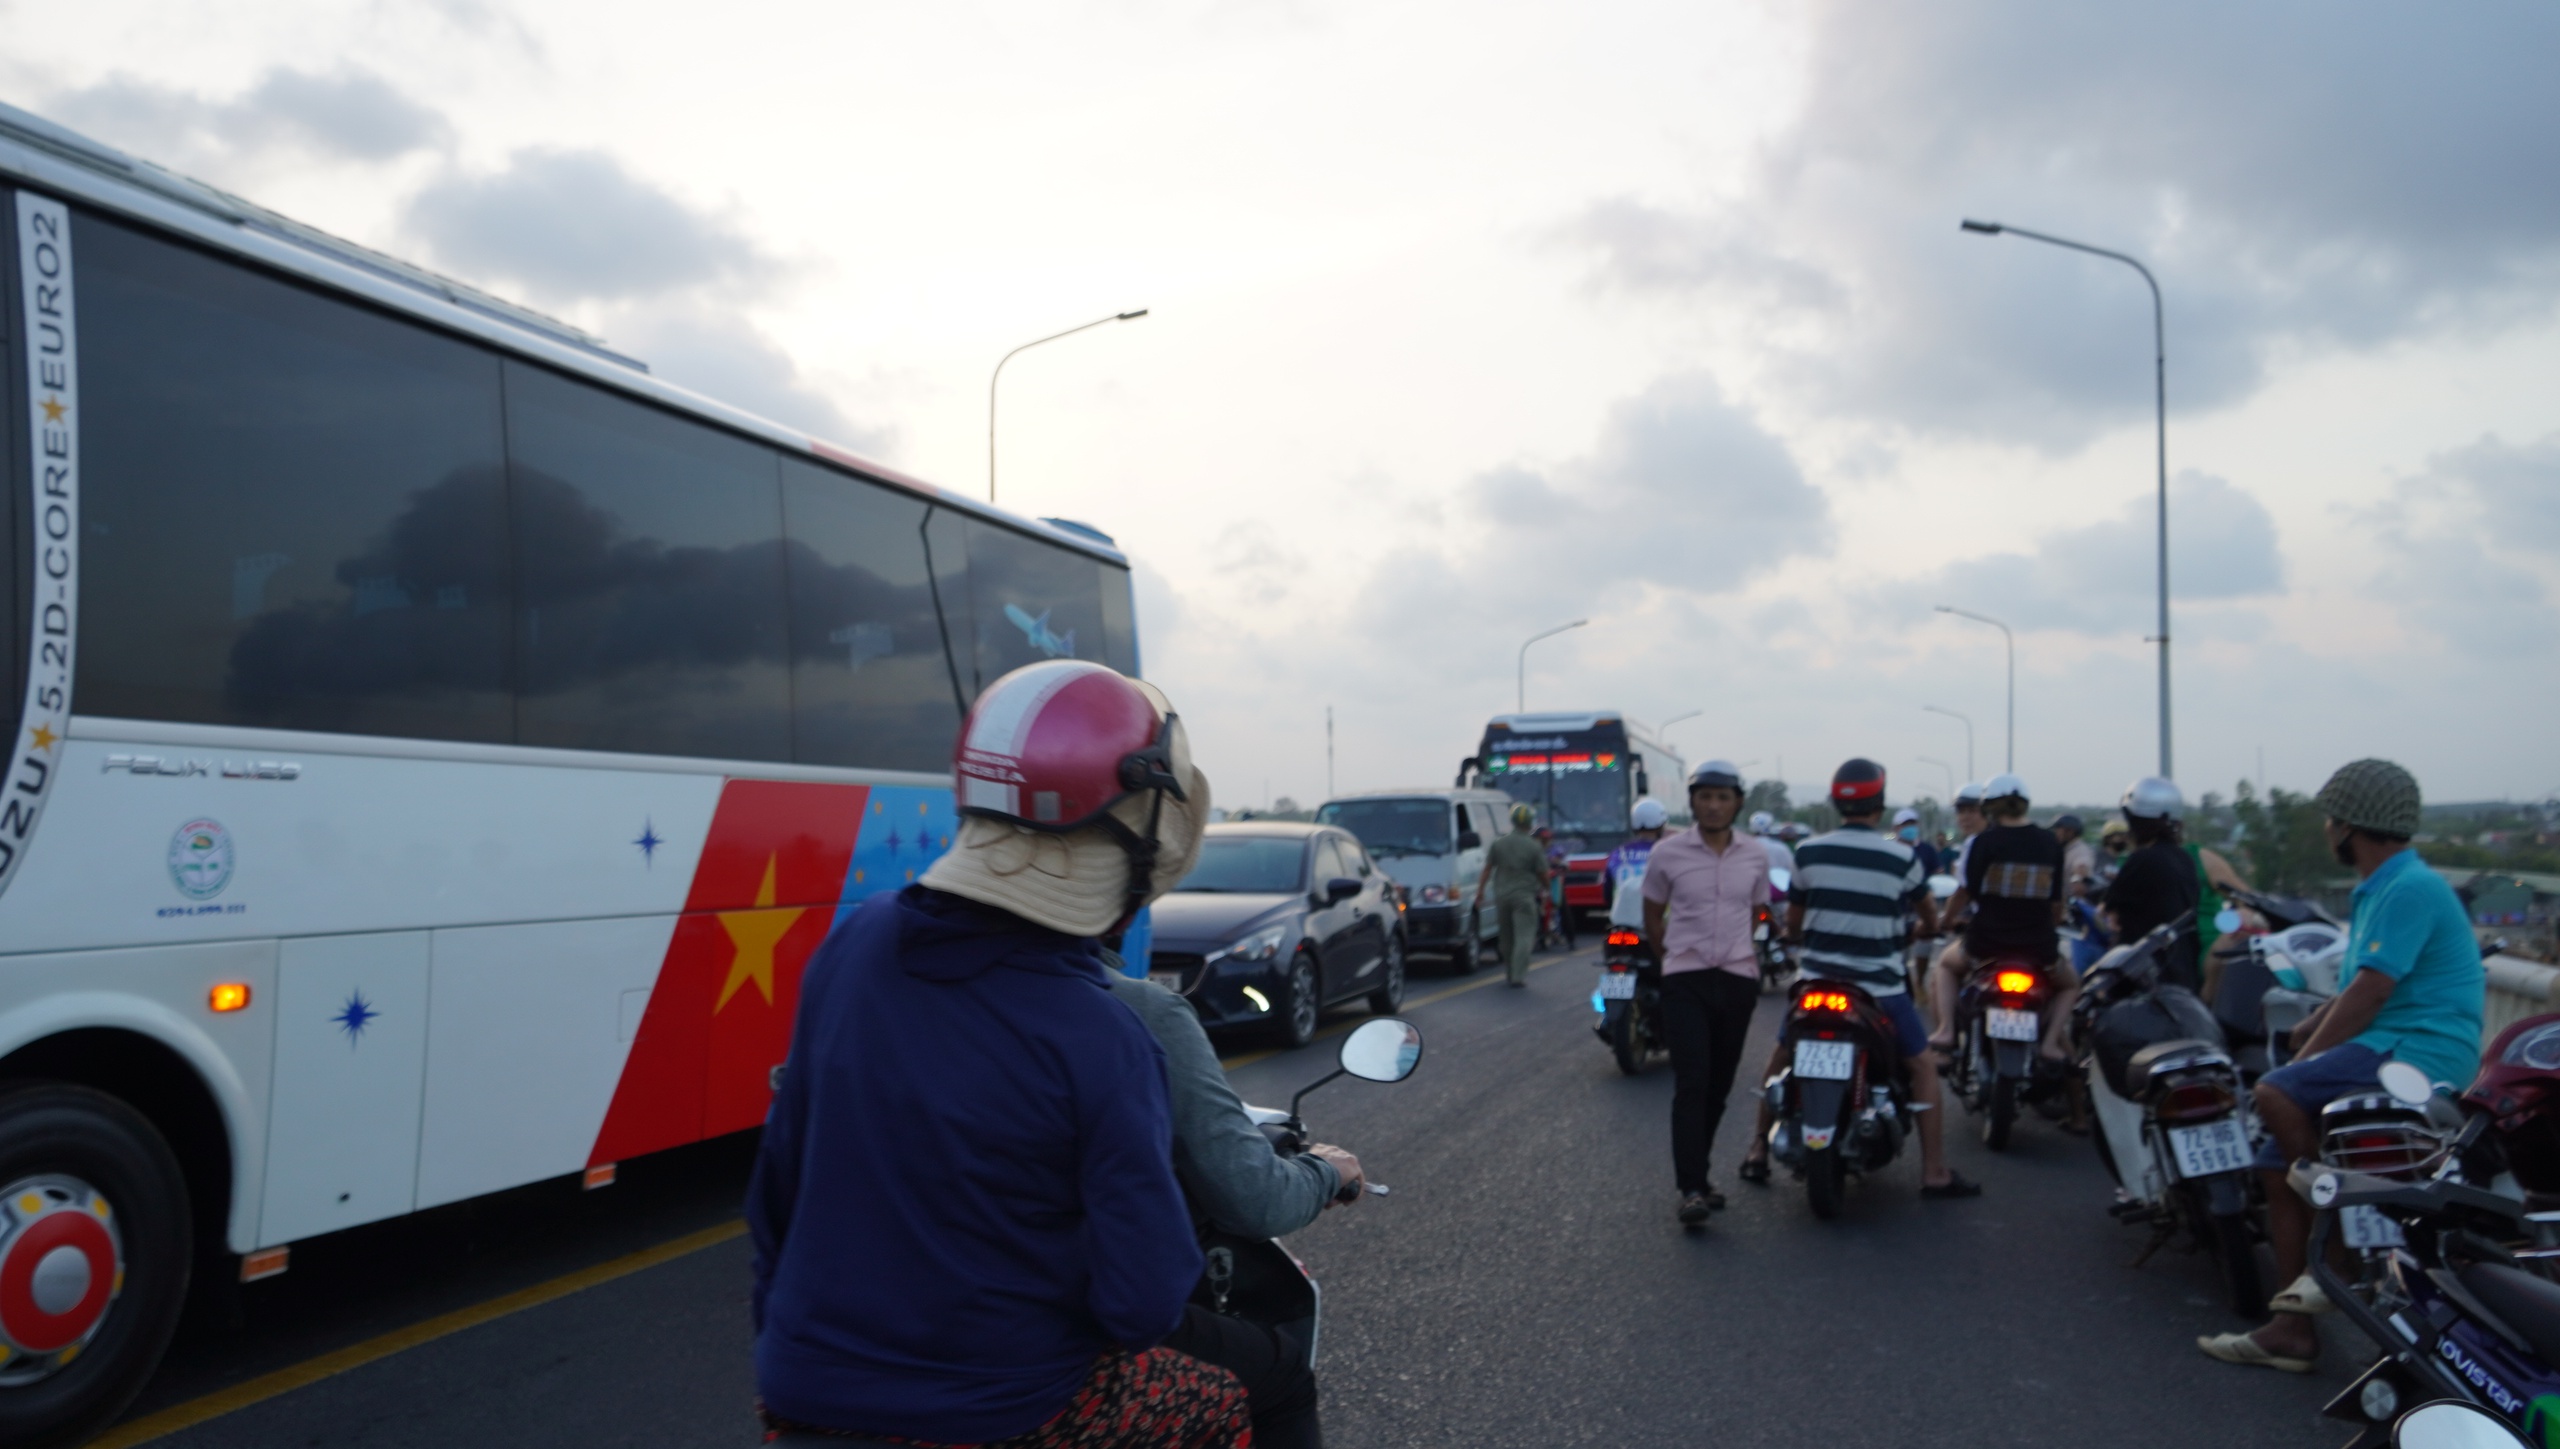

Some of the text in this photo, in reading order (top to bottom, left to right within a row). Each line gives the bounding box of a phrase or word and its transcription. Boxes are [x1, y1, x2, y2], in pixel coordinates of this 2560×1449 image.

[33, 211, 66, 391] EURO2
[38, 428, 70, 713] 5.2D-CORE
[2436, 1335, 2526, 1414] ovistar
